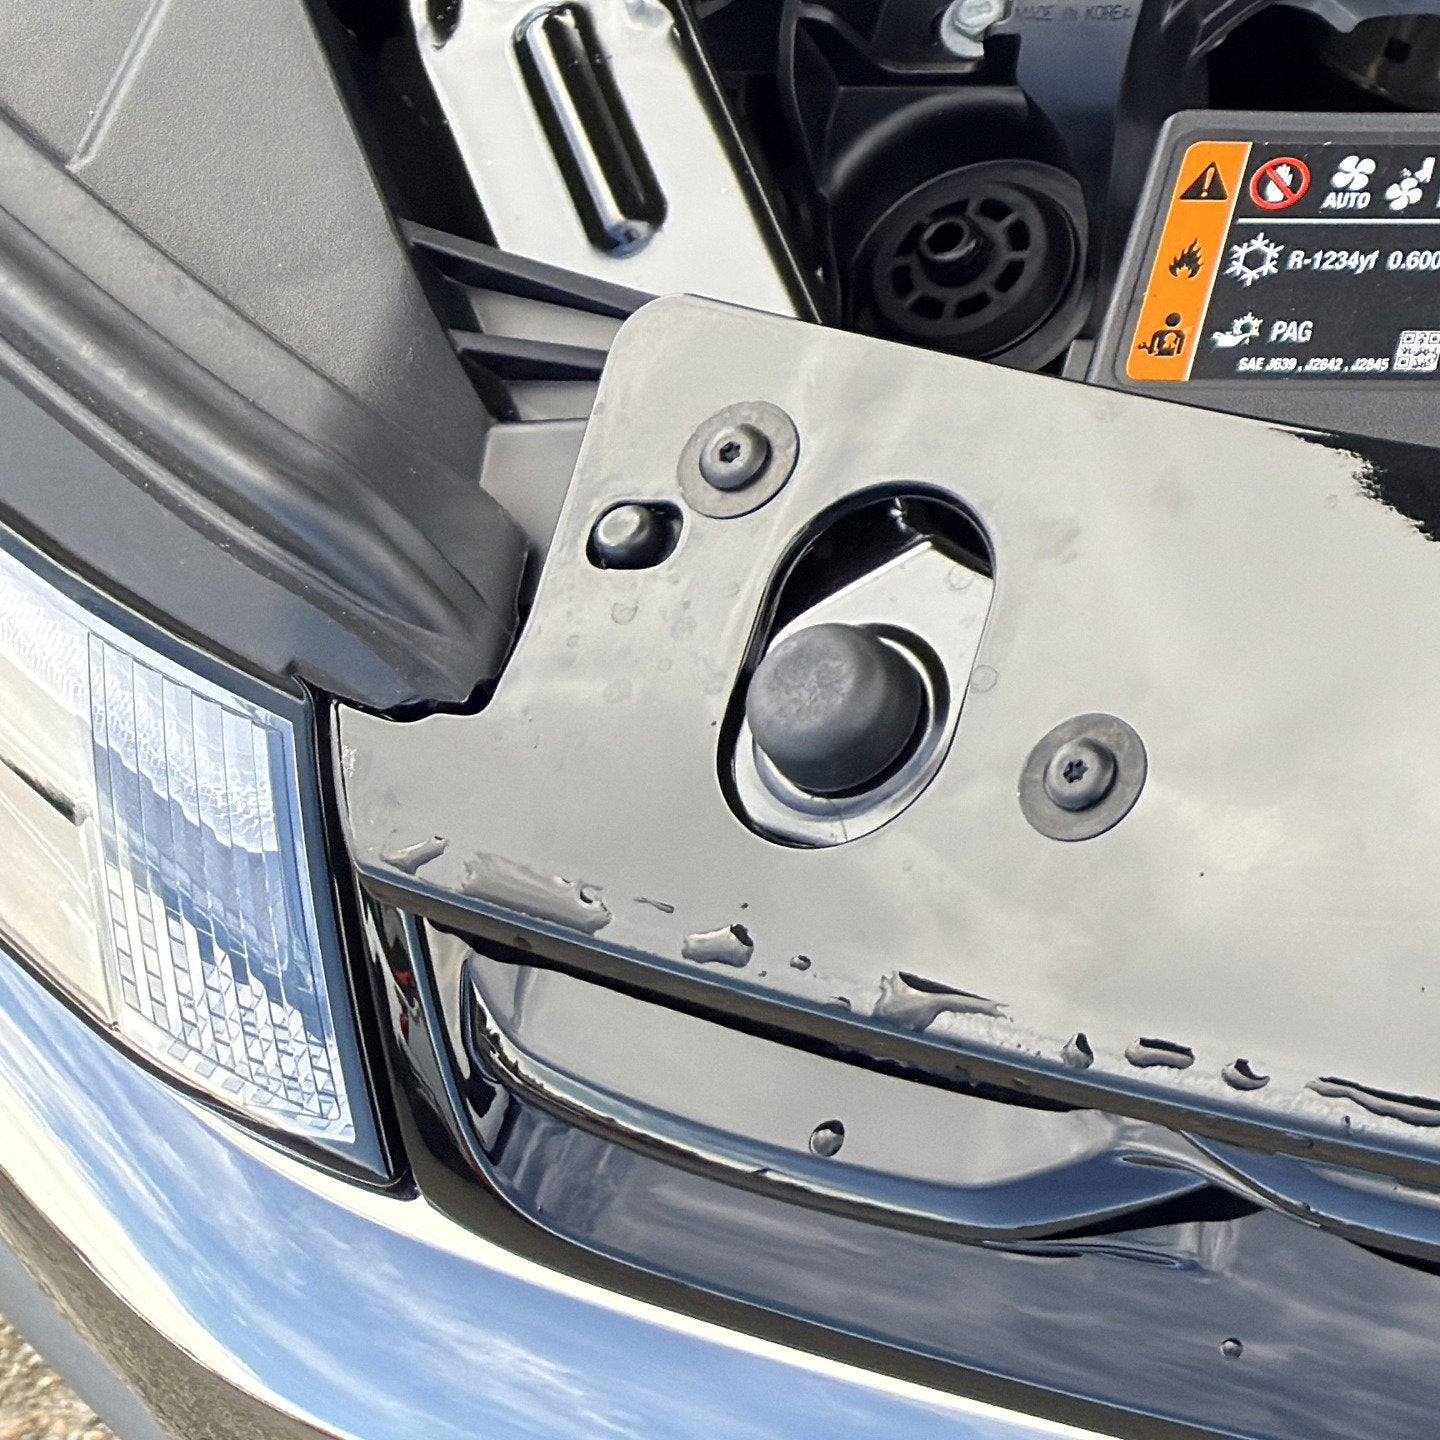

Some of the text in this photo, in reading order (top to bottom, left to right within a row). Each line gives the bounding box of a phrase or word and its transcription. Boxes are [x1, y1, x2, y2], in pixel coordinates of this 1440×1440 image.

[1085, 4, 1134, 21] KOREA
[1322, 191, 1371, 210] AUTO
[1288, 250, 1378, 275] R-1234yf
[1271, 320, 1314, 343] PAG
[1237, 357, 1264, 371] SAE
[1351, 357, 1390, 371] J2845
